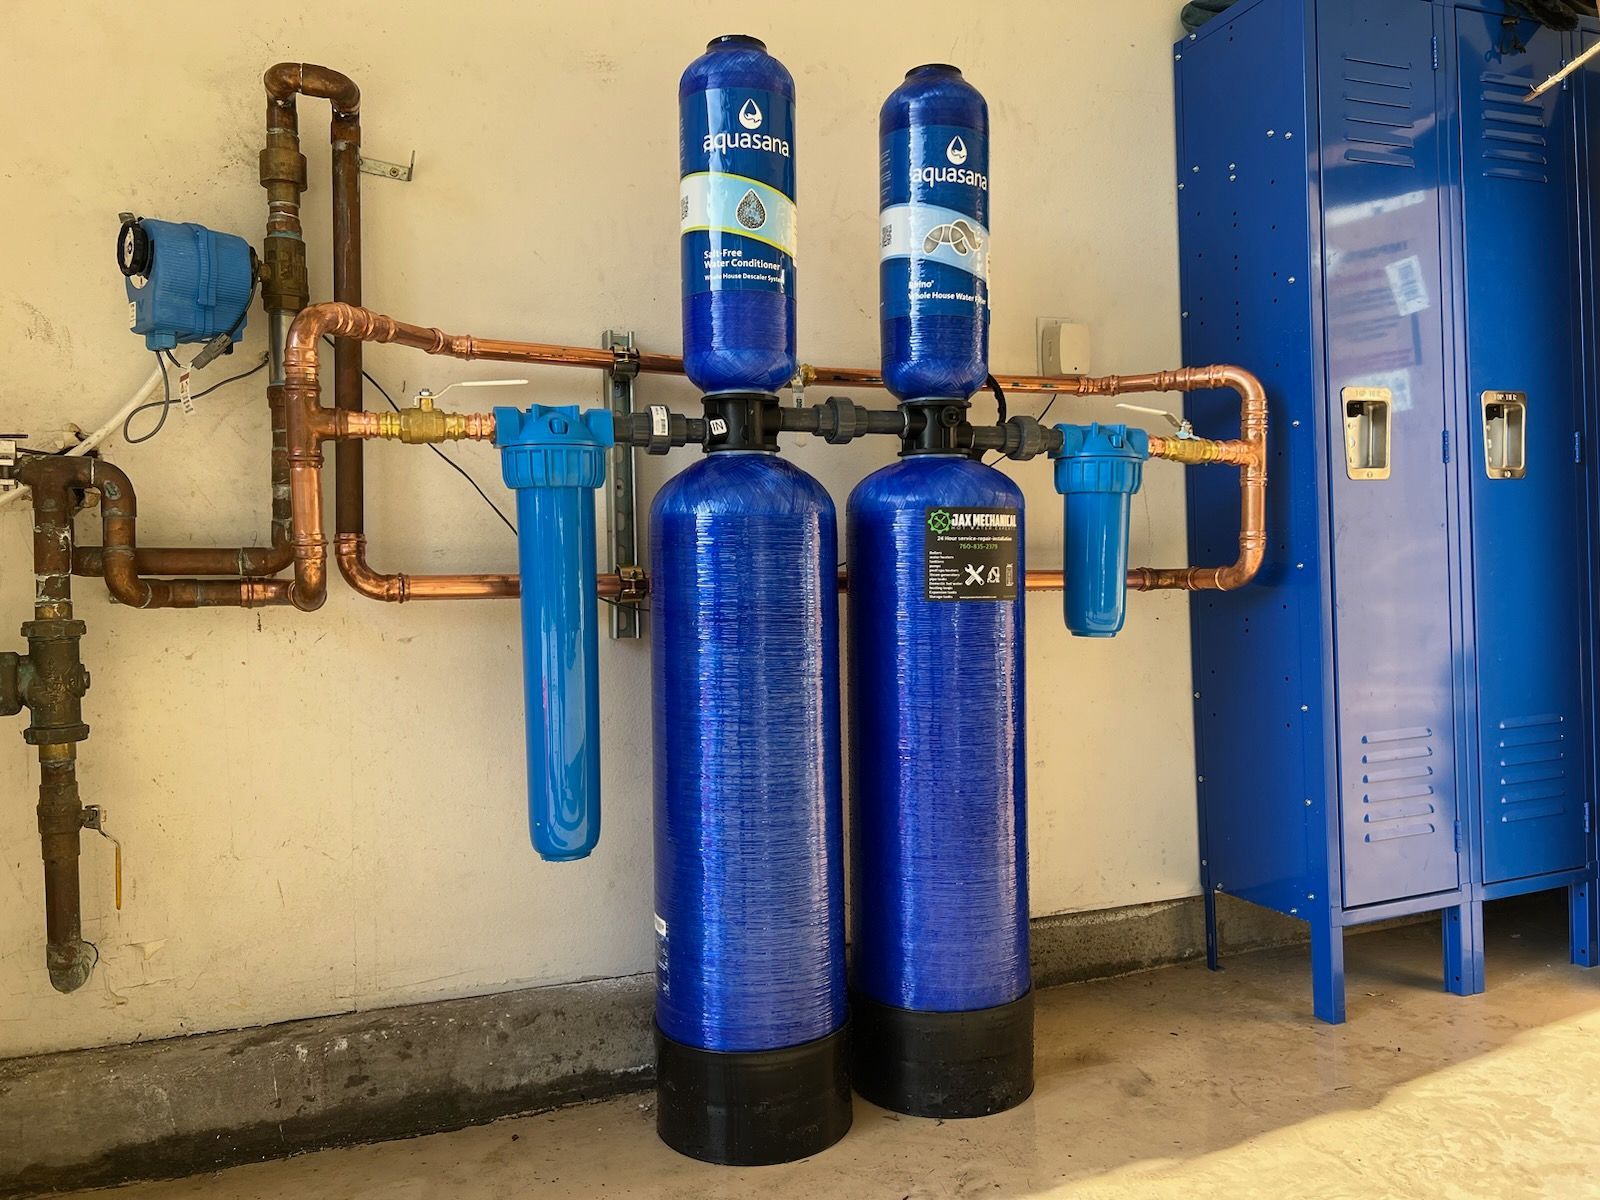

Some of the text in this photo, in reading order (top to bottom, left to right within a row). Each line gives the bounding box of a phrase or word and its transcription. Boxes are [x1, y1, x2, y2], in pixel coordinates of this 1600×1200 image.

[703, 132, 790, 157] aquasana
[911, 166, 987, 191] aquasana
[703, 258, 780, 271] Water Conditioner
[742, 273, 767, 281] Descaler
[931, 291, 955, 300] House
[956, 292, 974, 302] Water
[712, 421, 724, 431] IN
[951, 513, 1016, 527] JAX MECHANICAL
